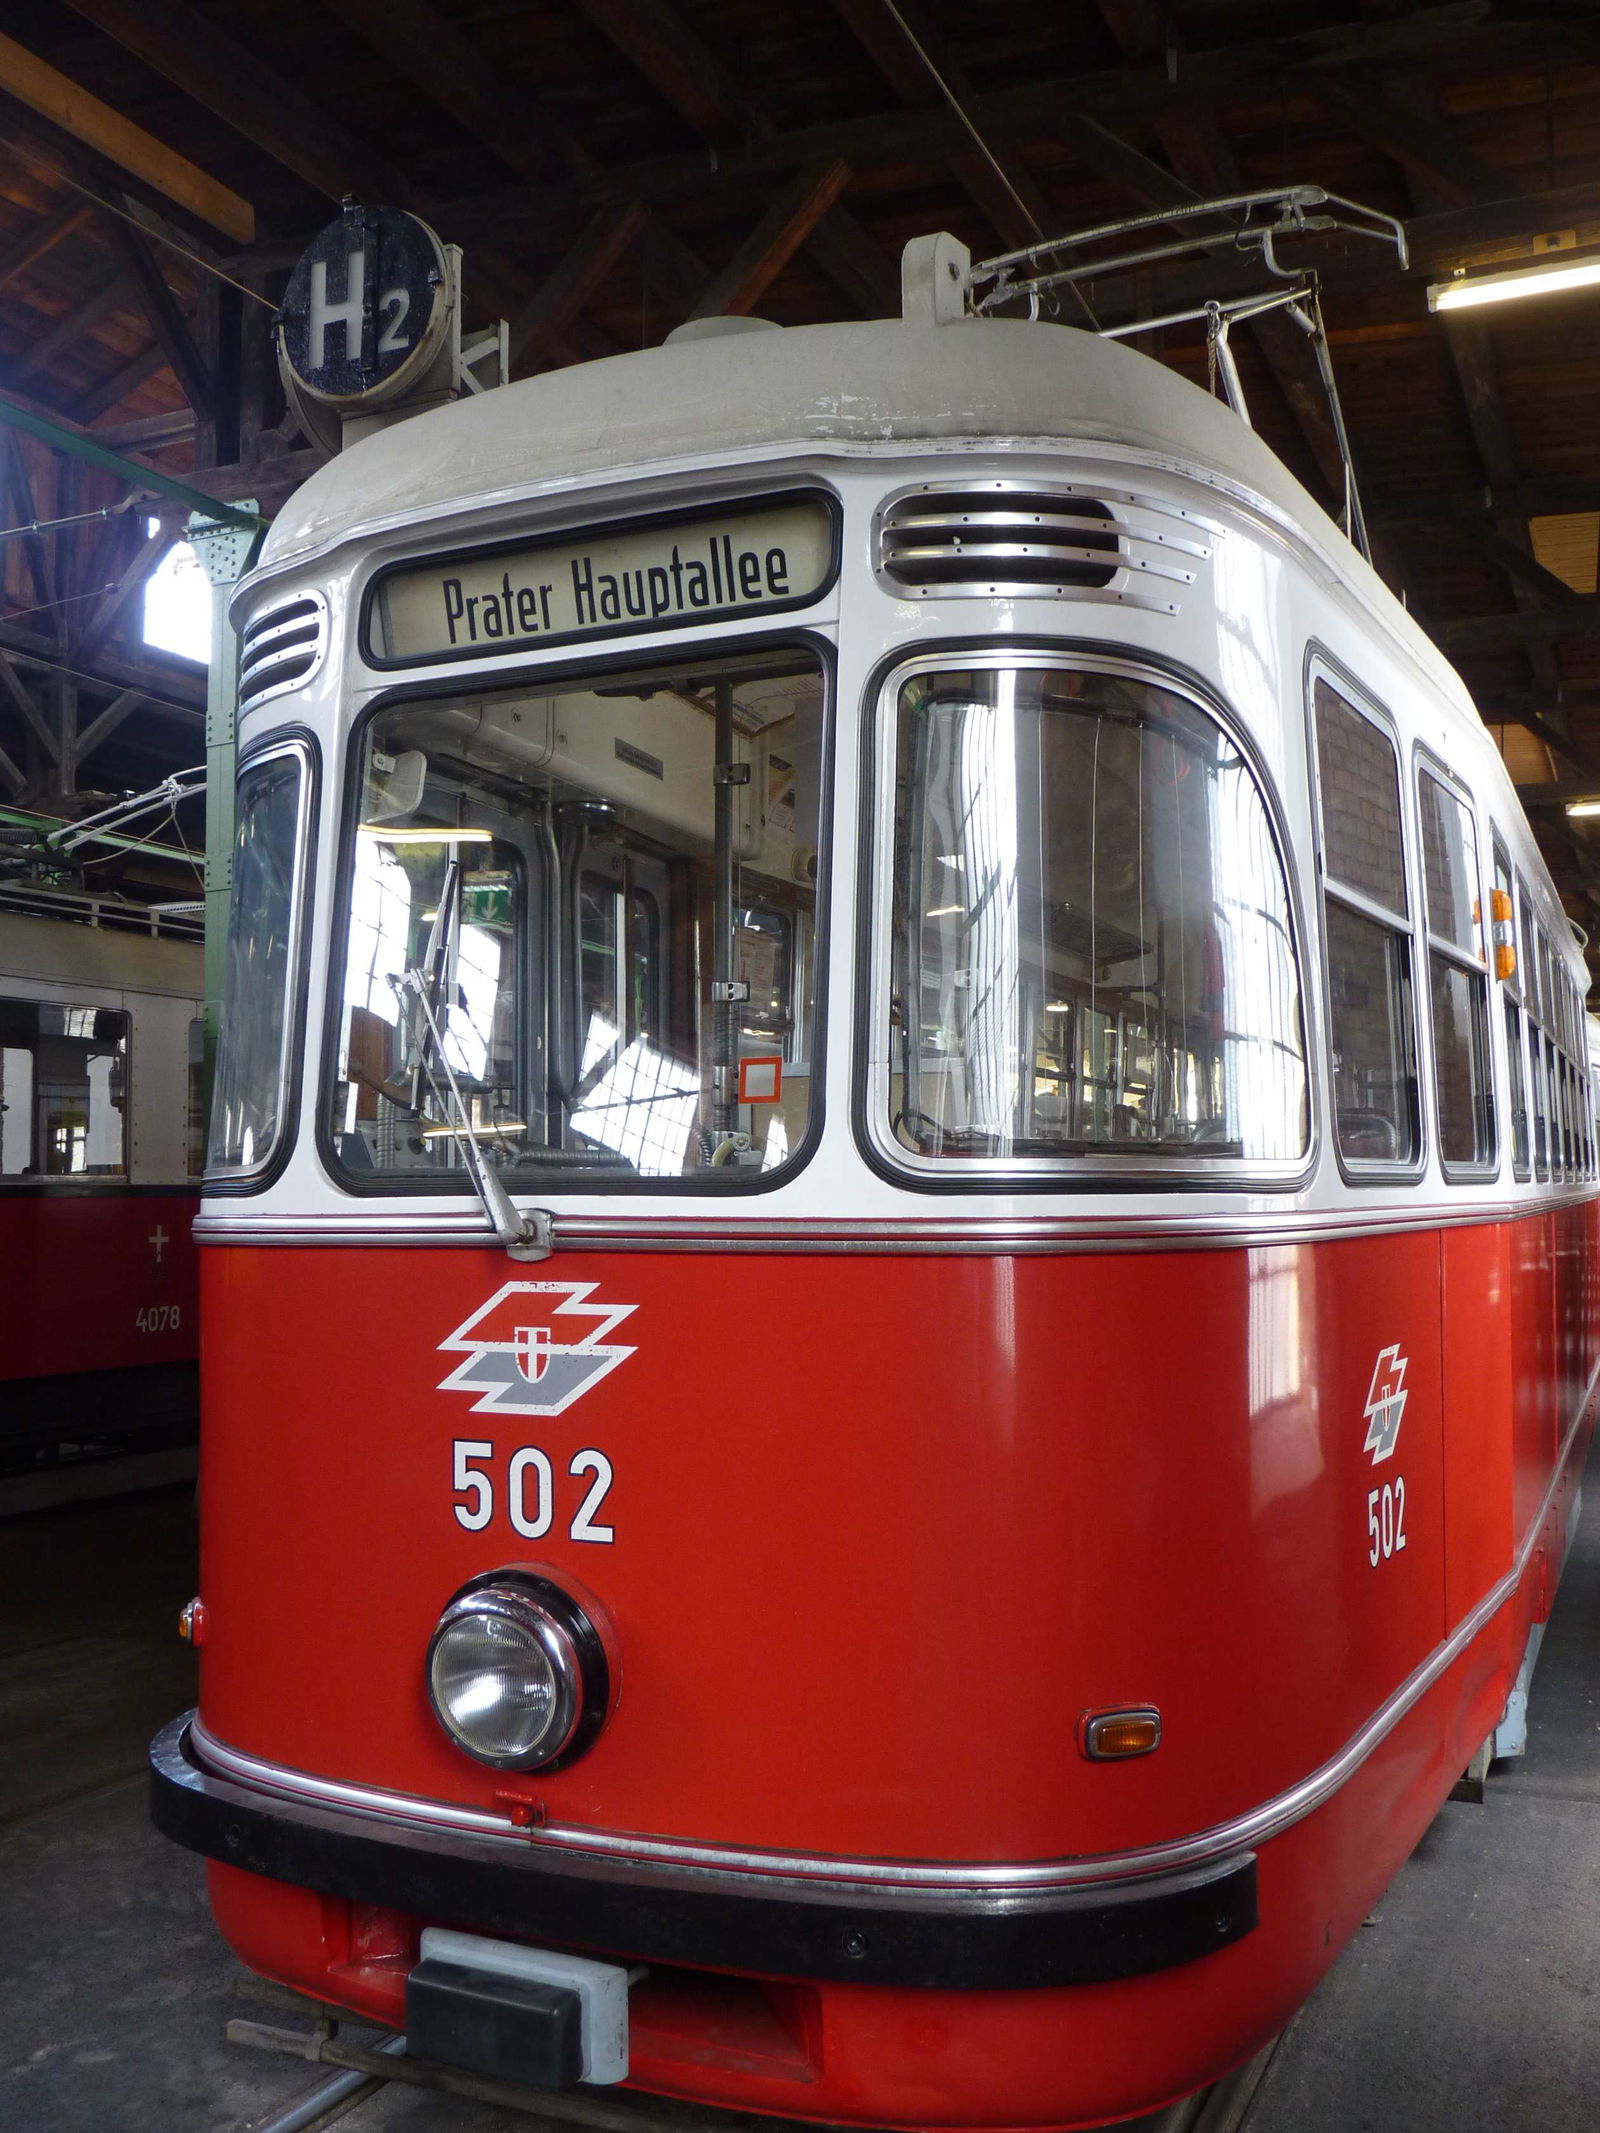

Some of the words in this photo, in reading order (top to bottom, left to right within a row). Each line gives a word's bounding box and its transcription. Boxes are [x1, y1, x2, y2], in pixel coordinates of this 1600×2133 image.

[443, 572, 553, 644] Prater
[571, 535, 790, 625] Hauptallee
[135, 1305, 181, 1332] 4078
[453, 1438, 615, 1545] 502
[1368, 1474, 1407, 1568] 502
